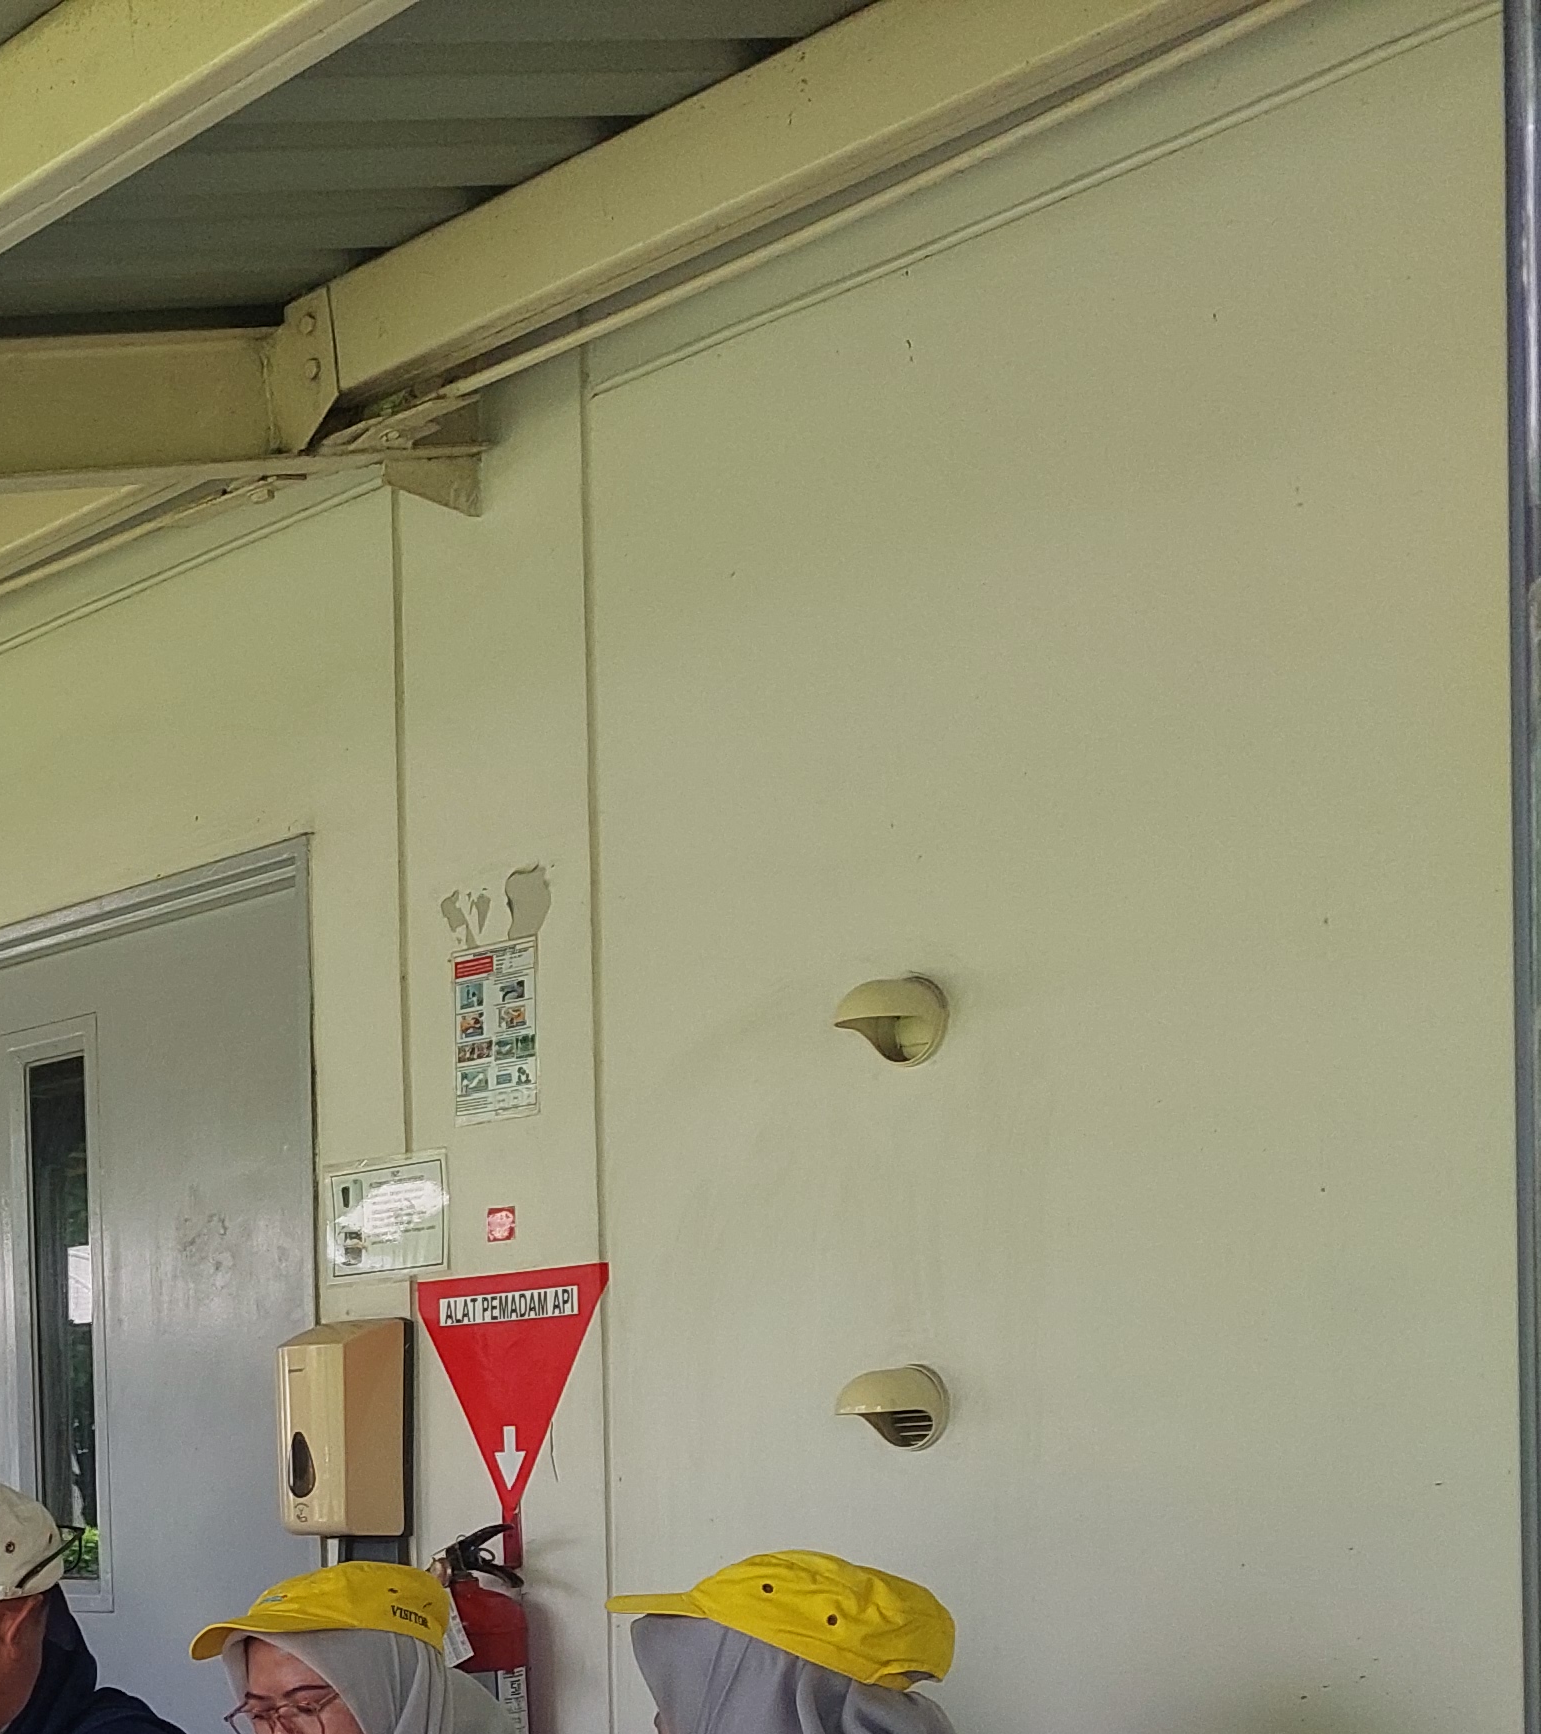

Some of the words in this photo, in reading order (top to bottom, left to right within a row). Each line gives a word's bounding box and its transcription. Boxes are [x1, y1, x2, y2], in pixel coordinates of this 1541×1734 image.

[444, 1297, 479, 1325] ALAT
[481, 1290, 549, 1322] PEMADAM
[551, 1287, 574, 1315] API
[390, 1604, 431, 1630] VISITOR
